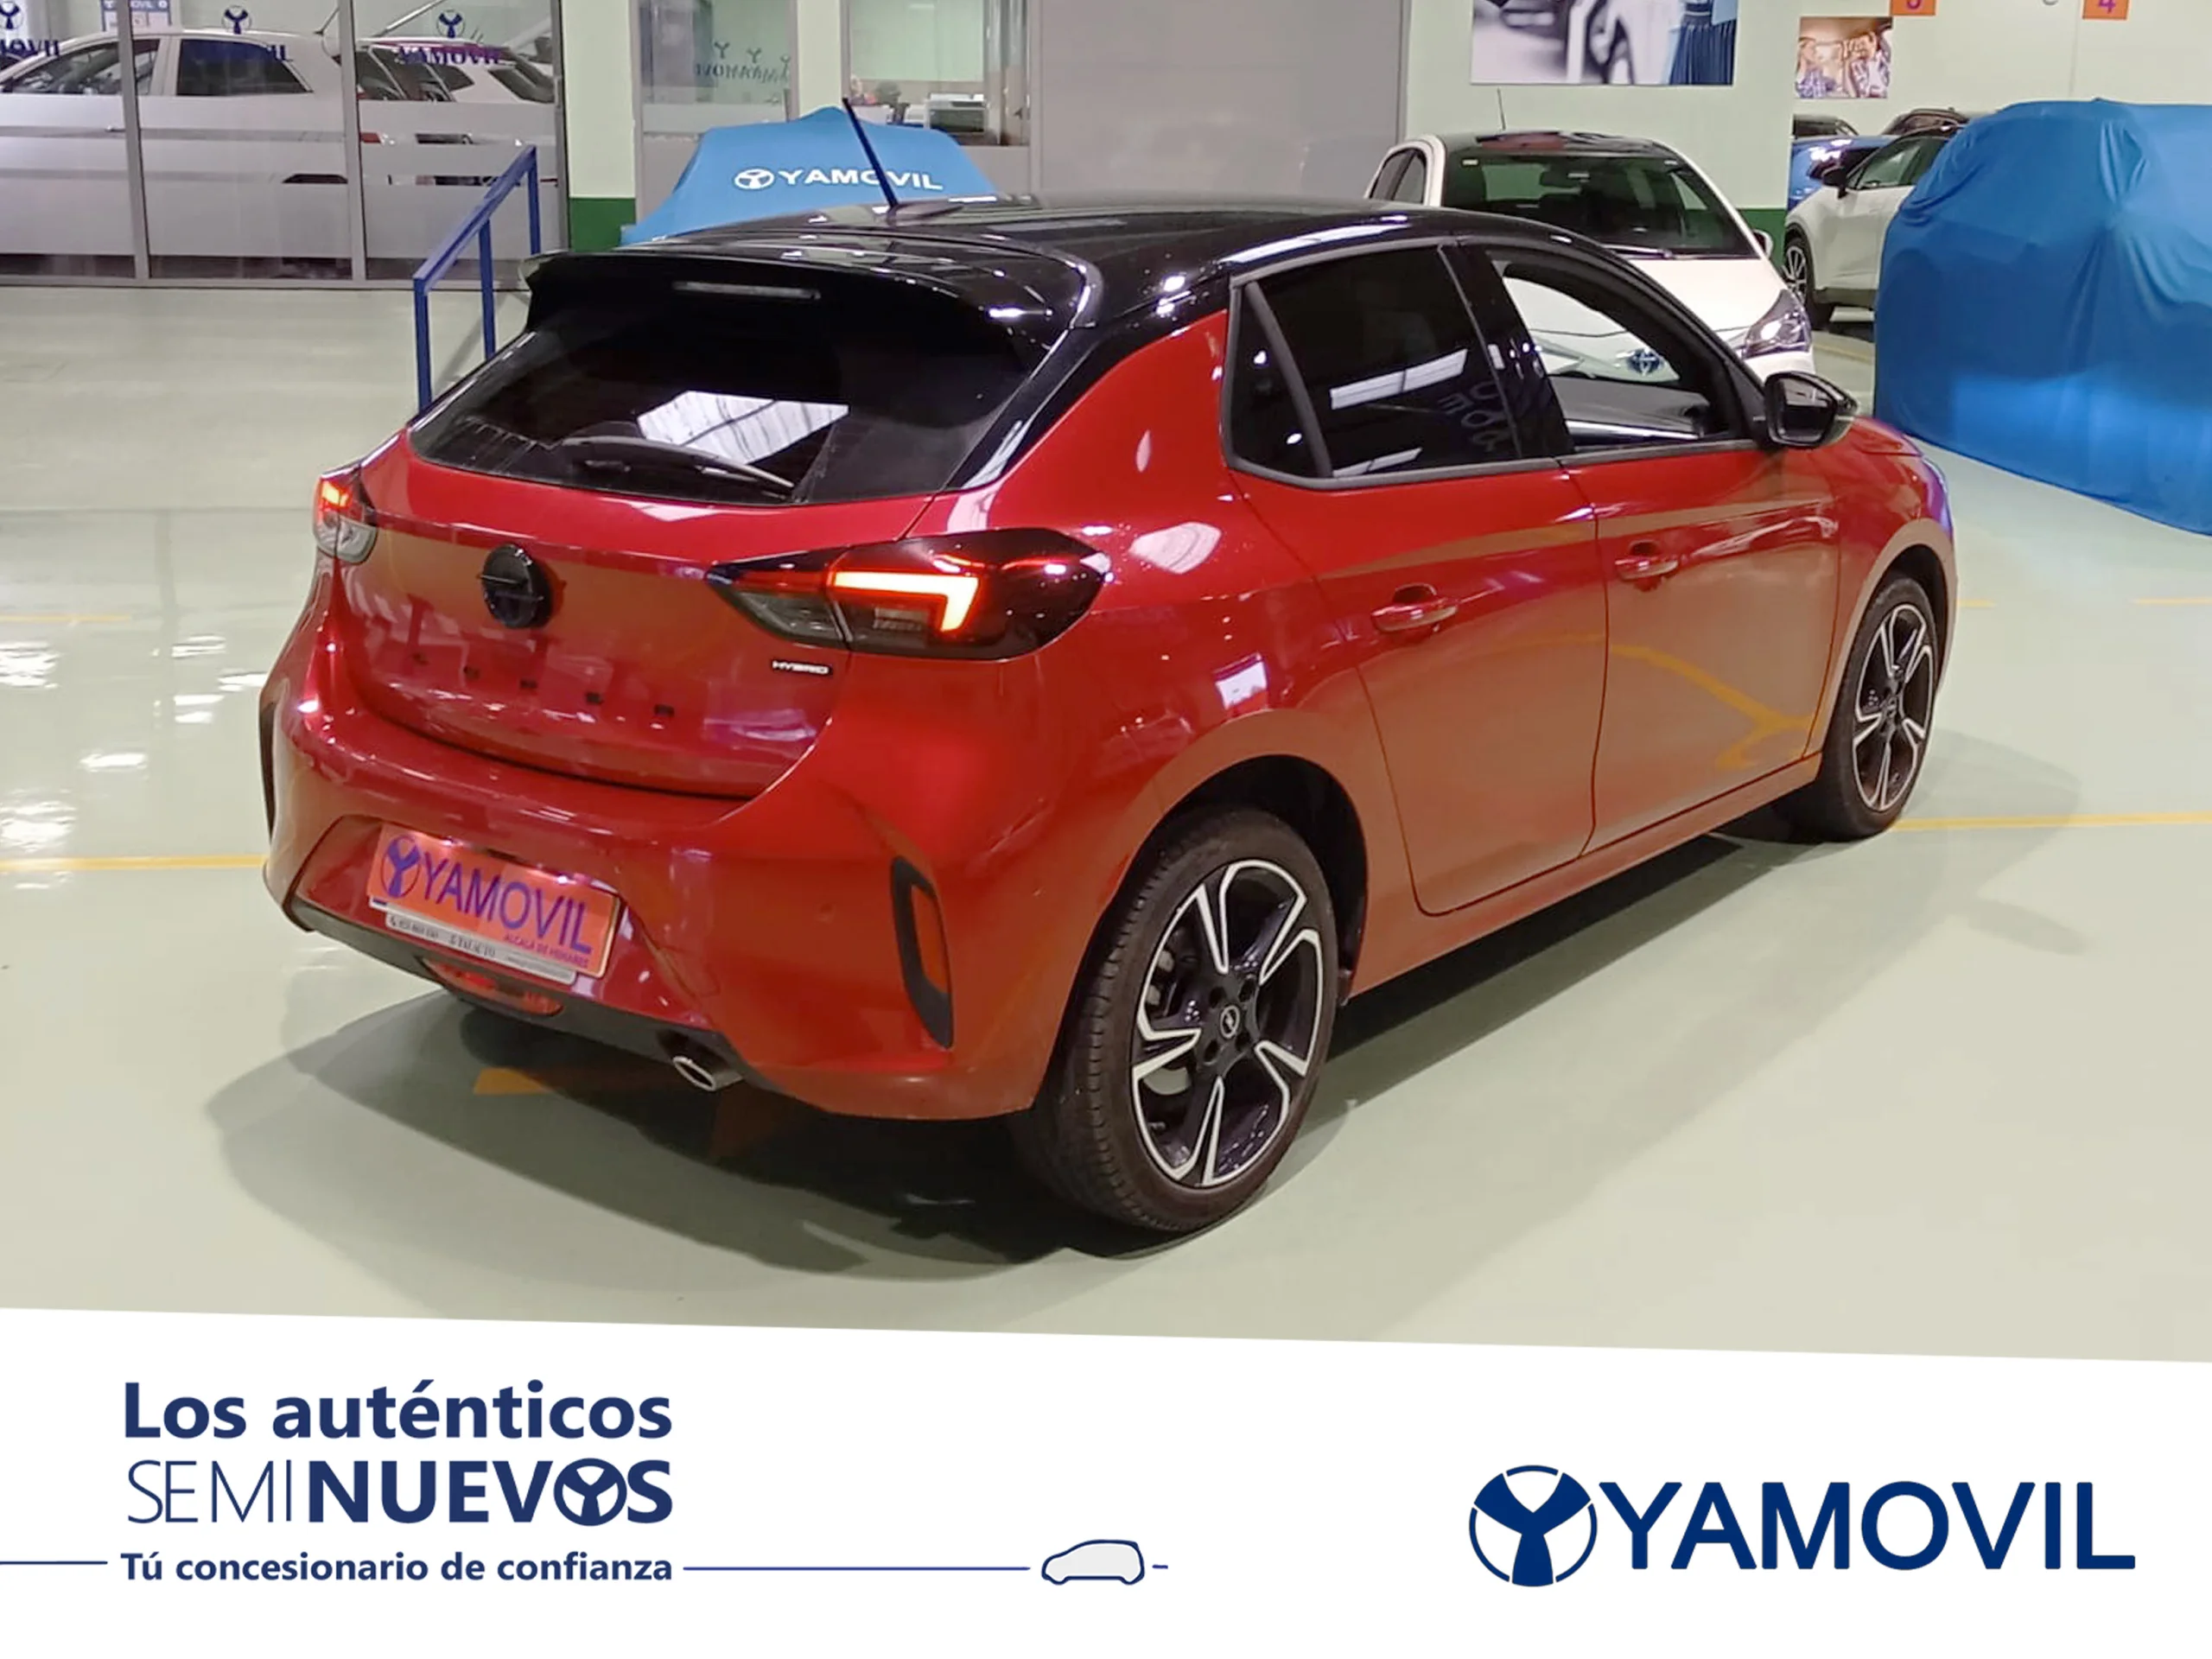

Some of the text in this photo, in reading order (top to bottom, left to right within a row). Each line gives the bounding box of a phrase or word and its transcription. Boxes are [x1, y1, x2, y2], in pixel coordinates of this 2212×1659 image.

[779, 168, 943, 190] YAMOVIL
[772, 660, 830, 674] HYBRID
[423, 851, 593, 955] YAMOVIL
